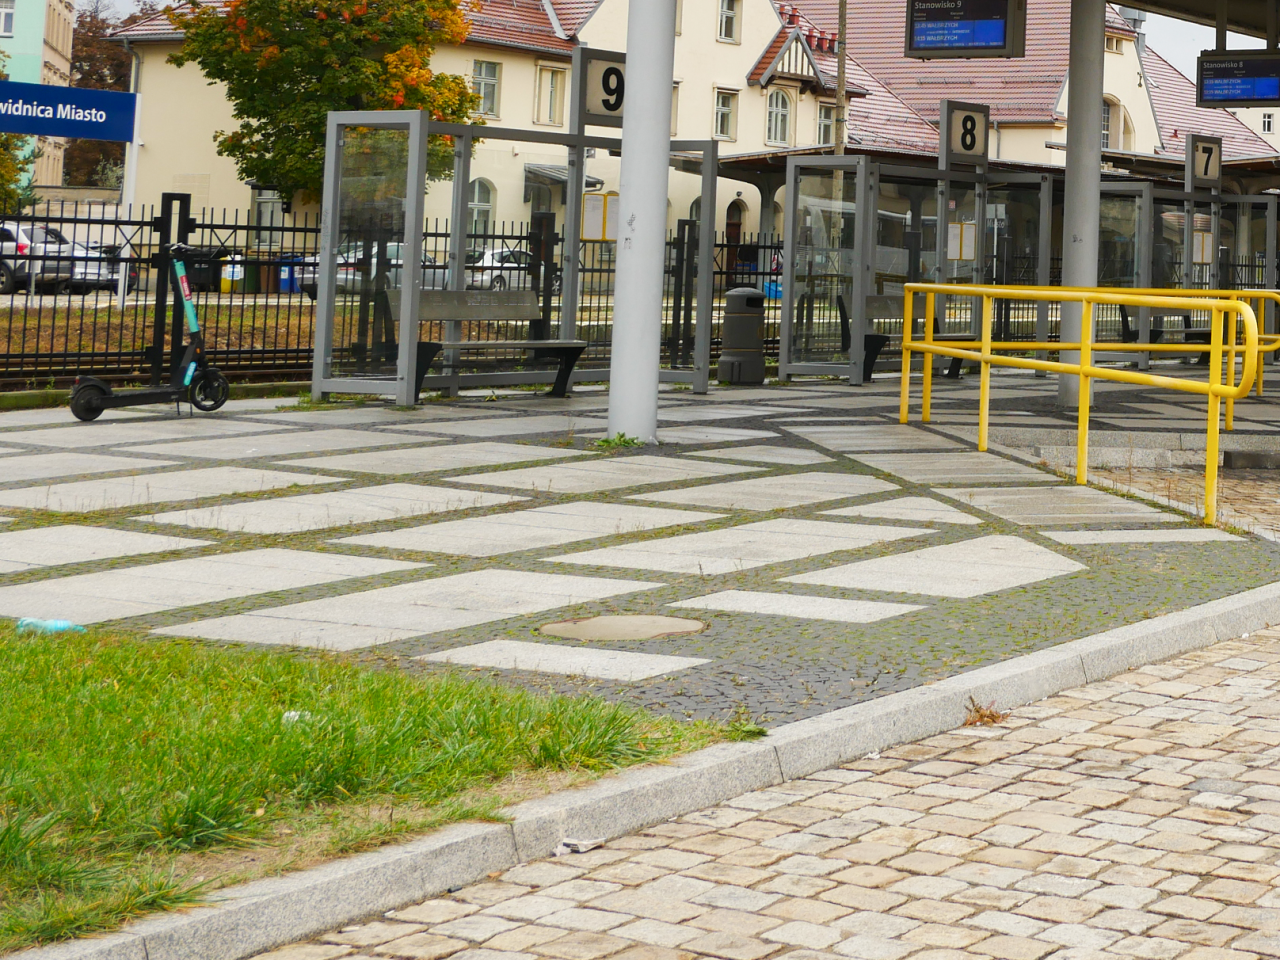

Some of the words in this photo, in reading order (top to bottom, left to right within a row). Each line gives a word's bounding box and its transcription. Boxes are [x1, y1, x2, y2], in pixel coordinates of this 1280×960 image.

[914, 1, 955, 9] Stanowisko
[957, 0, 962, 8] 9
[1203, 61, 1238, 69] Stanowisko
[602, 67, 625, 111] 9
[0, 99, 53, 118] widnica
[57, 103, 106, 122] Miasto
[961, 115, 976, 151] 8
[1202, 146, 1213, 176] 7
